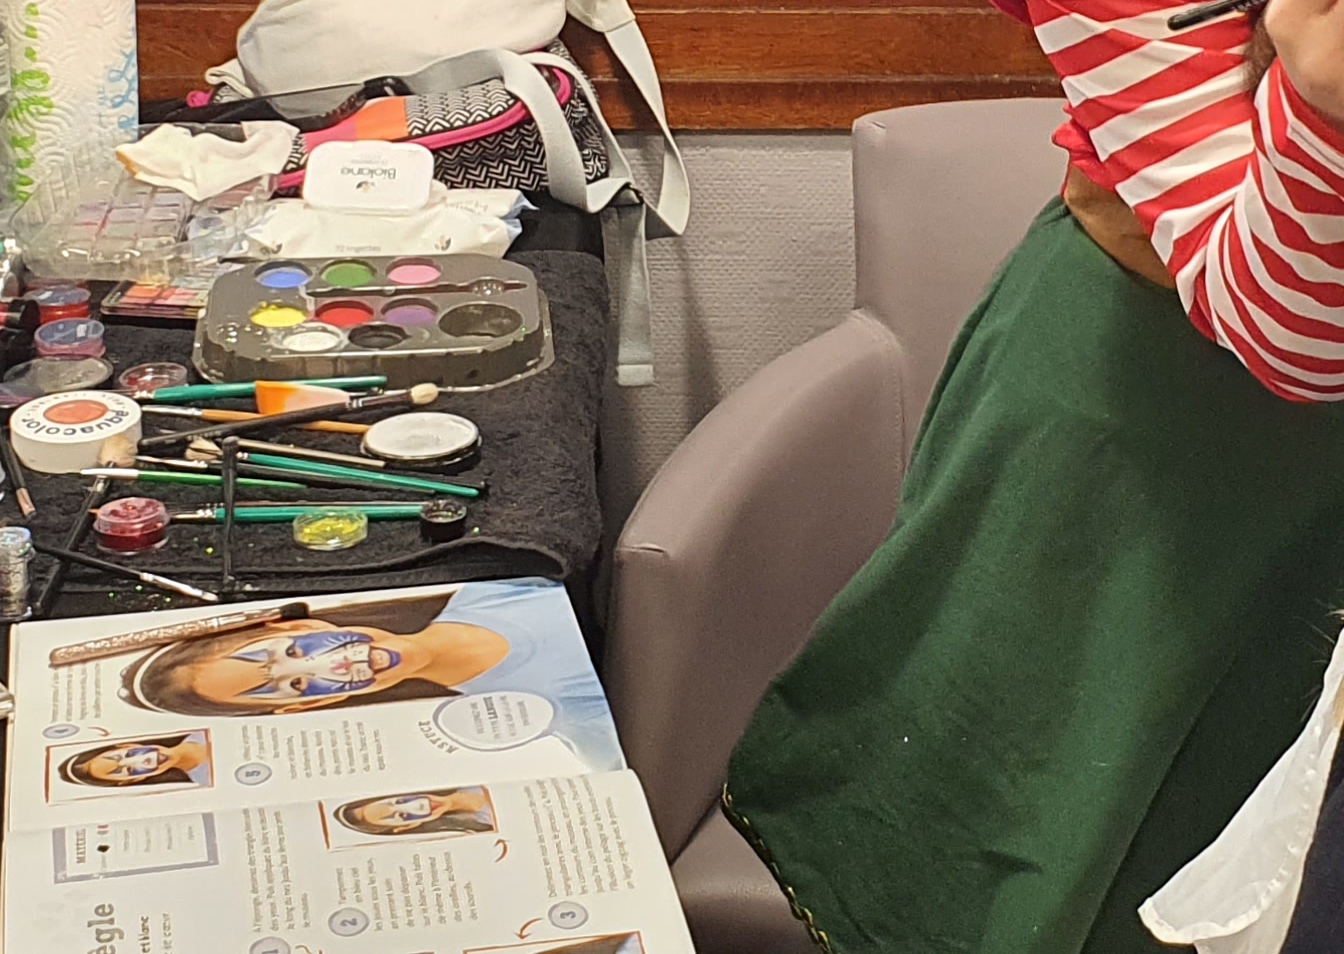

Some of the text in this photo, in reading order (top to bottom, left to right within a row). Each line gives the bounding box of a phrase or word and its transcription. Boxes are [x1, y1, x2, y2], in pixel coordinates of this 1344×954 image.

[340, 167, 397, 180] Biolane
[21, 409, 130, 436] aquacolor
[418, 720, 460, 754] ASTUCE
[245, 770, 261, 778] 5
[560, 911, 577, 919] 3
[341, 918, 357, 926] 2
